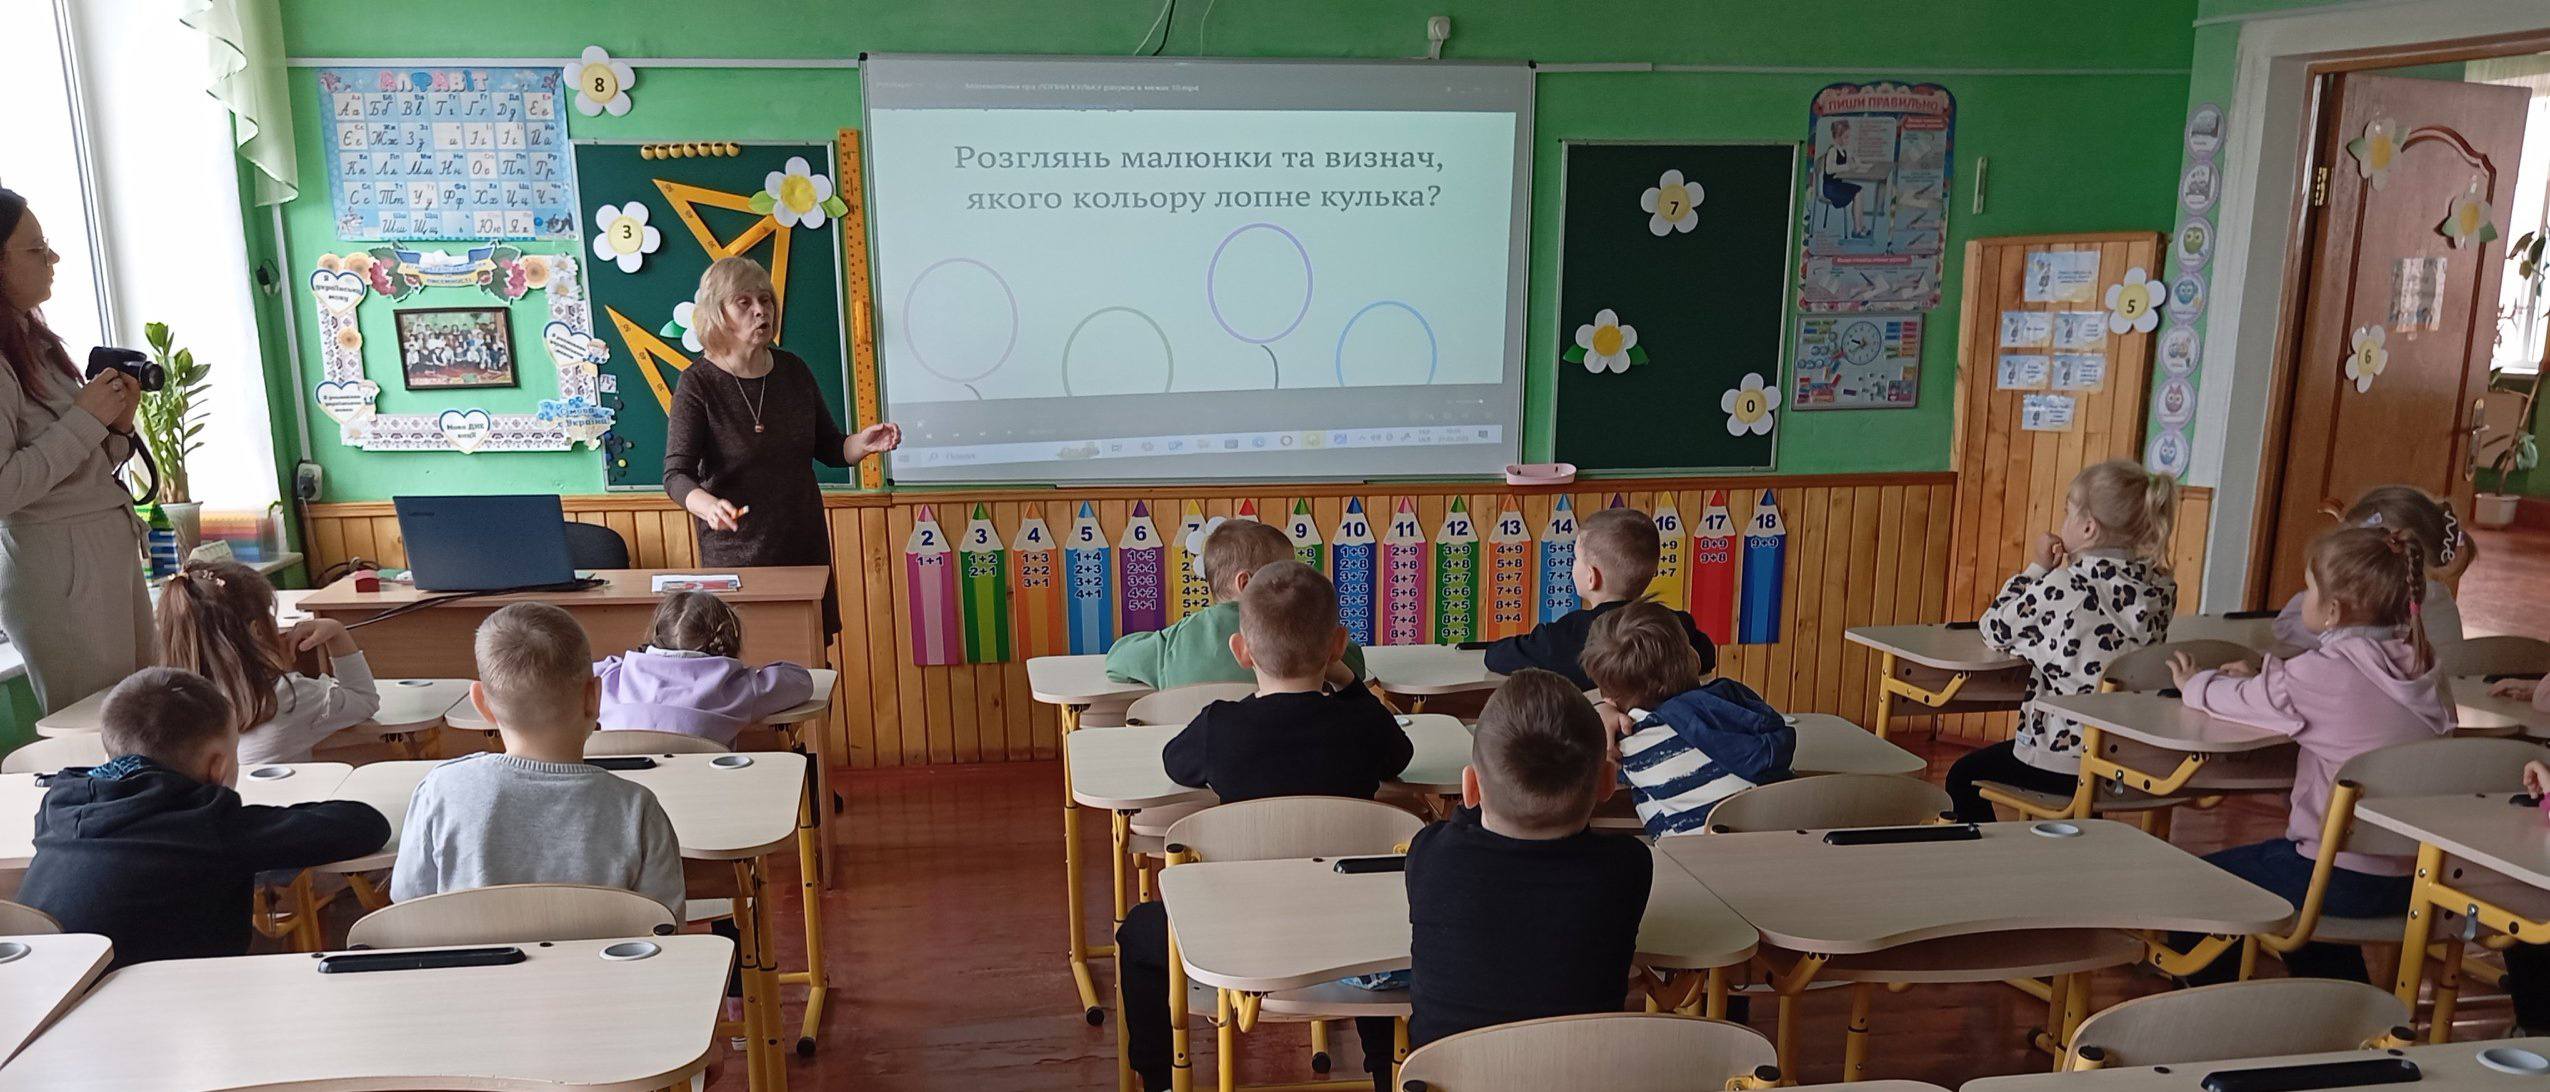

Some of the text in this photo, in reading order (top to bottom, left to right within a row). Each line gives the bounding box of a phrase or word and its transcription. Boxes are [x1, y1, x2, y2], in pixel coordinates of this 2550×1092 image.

[595, 78, 604, 92] 8
[954, 145, 1443, 173] Розглянь малюнки та визнач,
[967, 185, 1441, 214] якого кольору лопне кулька?
[1670, 201, 1679, 215] 7
[622, 225, 632, 239] 3
[2126, 299, 2136, 313] 5
[2365, 349, 2372, 364] 6
[1746, 400, 1755, 413] 0
[1552, 519, 1573, 534] 14
[1655, 516, 1677, 531] 16
[1705, 514, 1726, 530] 17
[1755, 514, 1776, 529] 18
[1295, 523, 1307, 538] 9
[1342, 522, 1366, 537] 10
[1396, 522, 1415, 537] 11
[1446, 521, 1468, 536] 12
[1499, 520, 1521, 535] 13
[921, 530, 934, 546] 2
[975, 528, 988, 544] 3
[1027, 527, 1041, 543] 4
[1080, 526, 1093, 542] 5
[1134, 526, 1147, 541] 6
[1700, 539, 1728, 550] 8+9
[1750, 538, 1778, 548] 9+9
[1341, 547, 1368, 557] 1+9
[1392, 547, 1417, 556] 2+9
[1443, 546, 1470, 556] 3+9
[1496, 544, 1524, 554] 4+9
[1548, 544, 1575, 554] 5+9
[917, 556, 944, 566] 1+1
[969, 554, 997, 564] 1+2
[1023, 553, 1049, 563] 1+3
[1075, 551, 1102, 562] 1+4
[1128, 551, 1156, 561] 1+5
[1700, 553, 1728, 563] 9+8
[1341, 559, 1368, 569] 2+8
[1392, 560, 1417, 570] 3+8
[1443, 559, 1470, 569] 4+8
[1496, 558, 1523, 568] 5+8
[1548, 558, 1574, 567] 6+8
[969, 567, 996, 577] 2+1
[1022, 566, 1050, 576] 2+2
[1075, 564, 1102, 574] 2+3
[1127, 564, 1156, 574] 2+4
[1128, 576, 1156, 586] 3+3
[1340, 572, 1368, 581] 3+7
[1391, 574, 1417, 584] 4+7
[1443, 573, 1470, 583] 5+7
[1496, 572, 1522, 582] 6+7
[1548, 571, 1573, 581] 7+7
[1023, 578, 1049, 588] 3+1
[1075, 577, 1102, 586] 3+2
[1128, 588, 1157, 599] 4+2
[1182, 586, 1209, 595] 4+3
[1340, 584, 1368, 593] 4+6
[1391, 588, 1417, 598] 5+6
[1443, 587, 1470, 597] 6+6
[1496, 585, 1522, 595] 7+6
[1547, 585, 1573, 595] 8+6
[1075, 589, 1102, 599] 4+1
[1128, 600, 1156, 610] 5+1
[1182, 598, 1209, 608] 5+2
[1340, 596, 1368, 605] 5+5
[1443, 601, 1469, 610] 7+5
[1495, 599, 1521, 609] 8+5
[1547, 599, 1573, 608] 9+5
[1391, 602, 1417, 611] 6+5
[1340, 608, 1368, 617] 6+4
[1391, 615, 1416, 625] 7+4
[1442, 614, 1469, 623] 8+4
[1495, 613, 1521, 623] 9+4
[1340, 620, 1367, 629] 7+3
[1391, 629, 1416, 638] 8+3
[1442, 627, 1469, 637] 9+3
